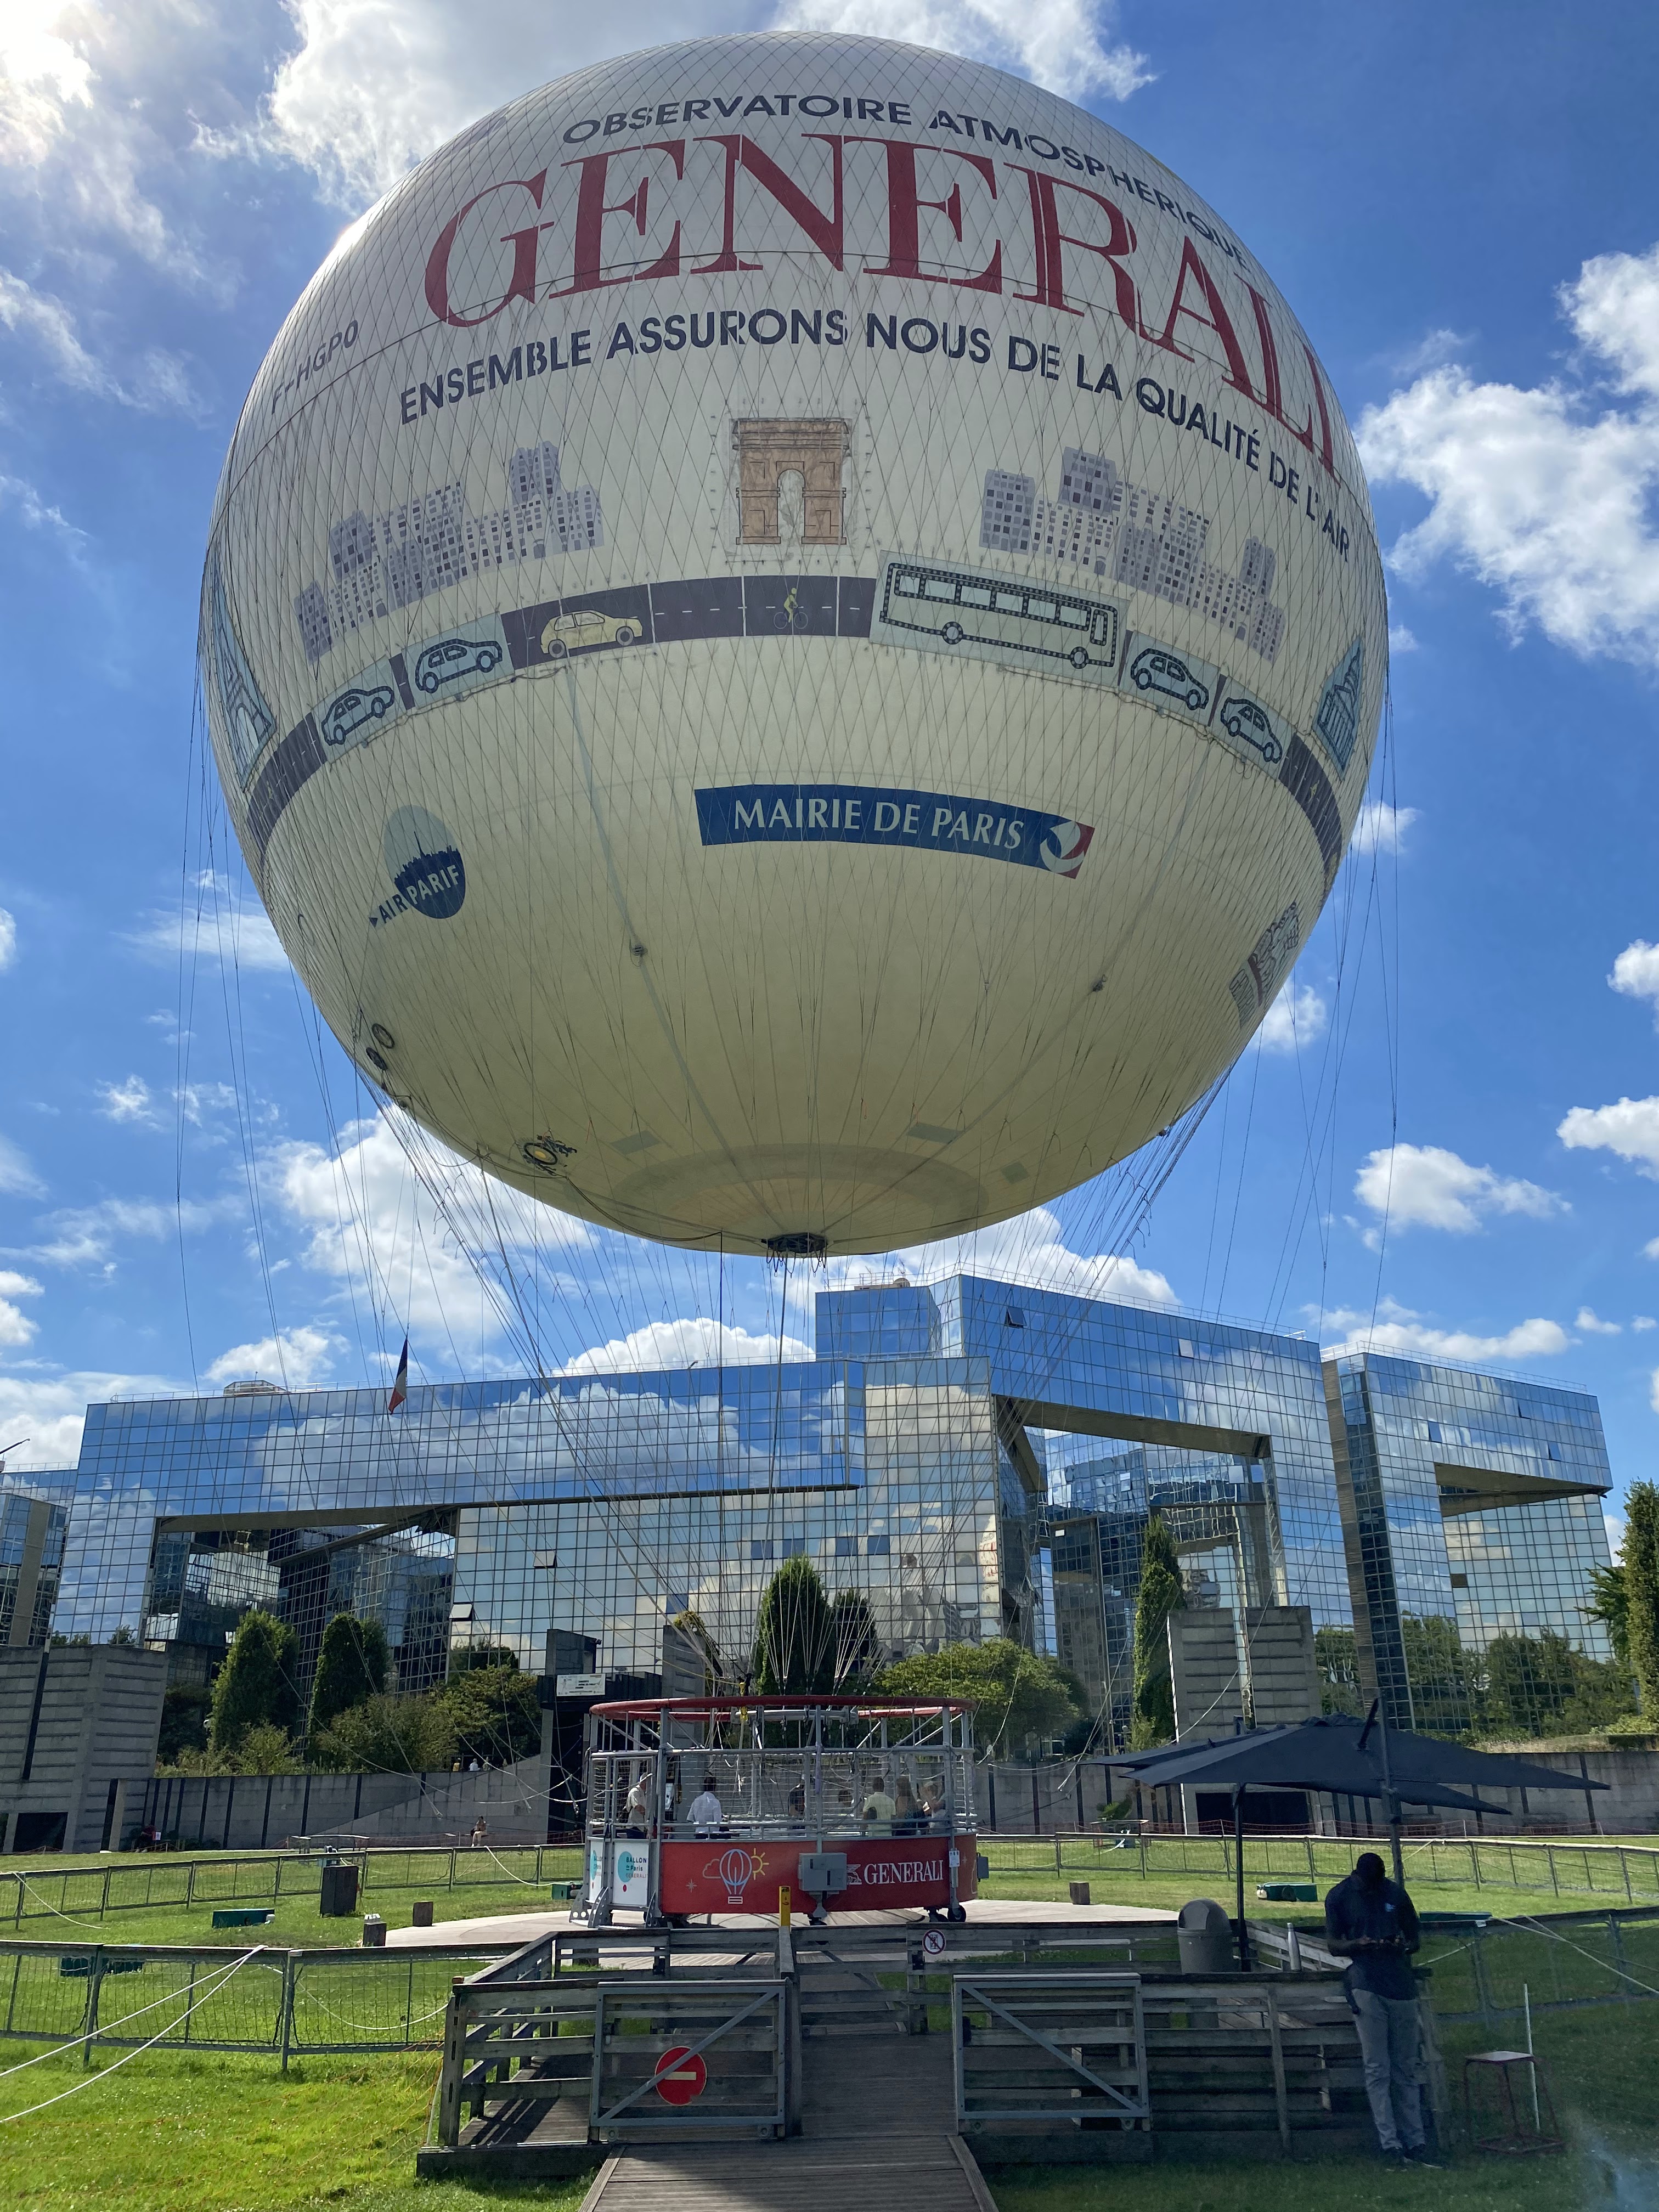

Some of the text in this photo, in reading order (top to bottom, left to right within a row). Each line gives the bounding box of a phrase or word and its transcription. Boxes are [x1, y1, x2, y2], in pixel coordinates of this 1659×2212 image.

[562, 94, 1250, 273] OBSERVATOIRE ATMOSPHERIQUE
[272, 320, 358, 415] F-HGPO
[425, 133, 1341, 488] GENERALI
[401, 330, 591, 425] ENSEMBLE
[606, 308, 848, 359] ASSURONS
[867, 312, 991, 364] NOUS
[1008, 335, 1060, 380] DE
[1077, 354, 1122, 401] LA
[1136, 377, 1260, 471] QUALITÉ
[1269, 451, 1299, 504] DE
[735, 798, 1024, 850] MAIRIE DE PARIS
[864, 1860, 944, 1885] GENERALI
